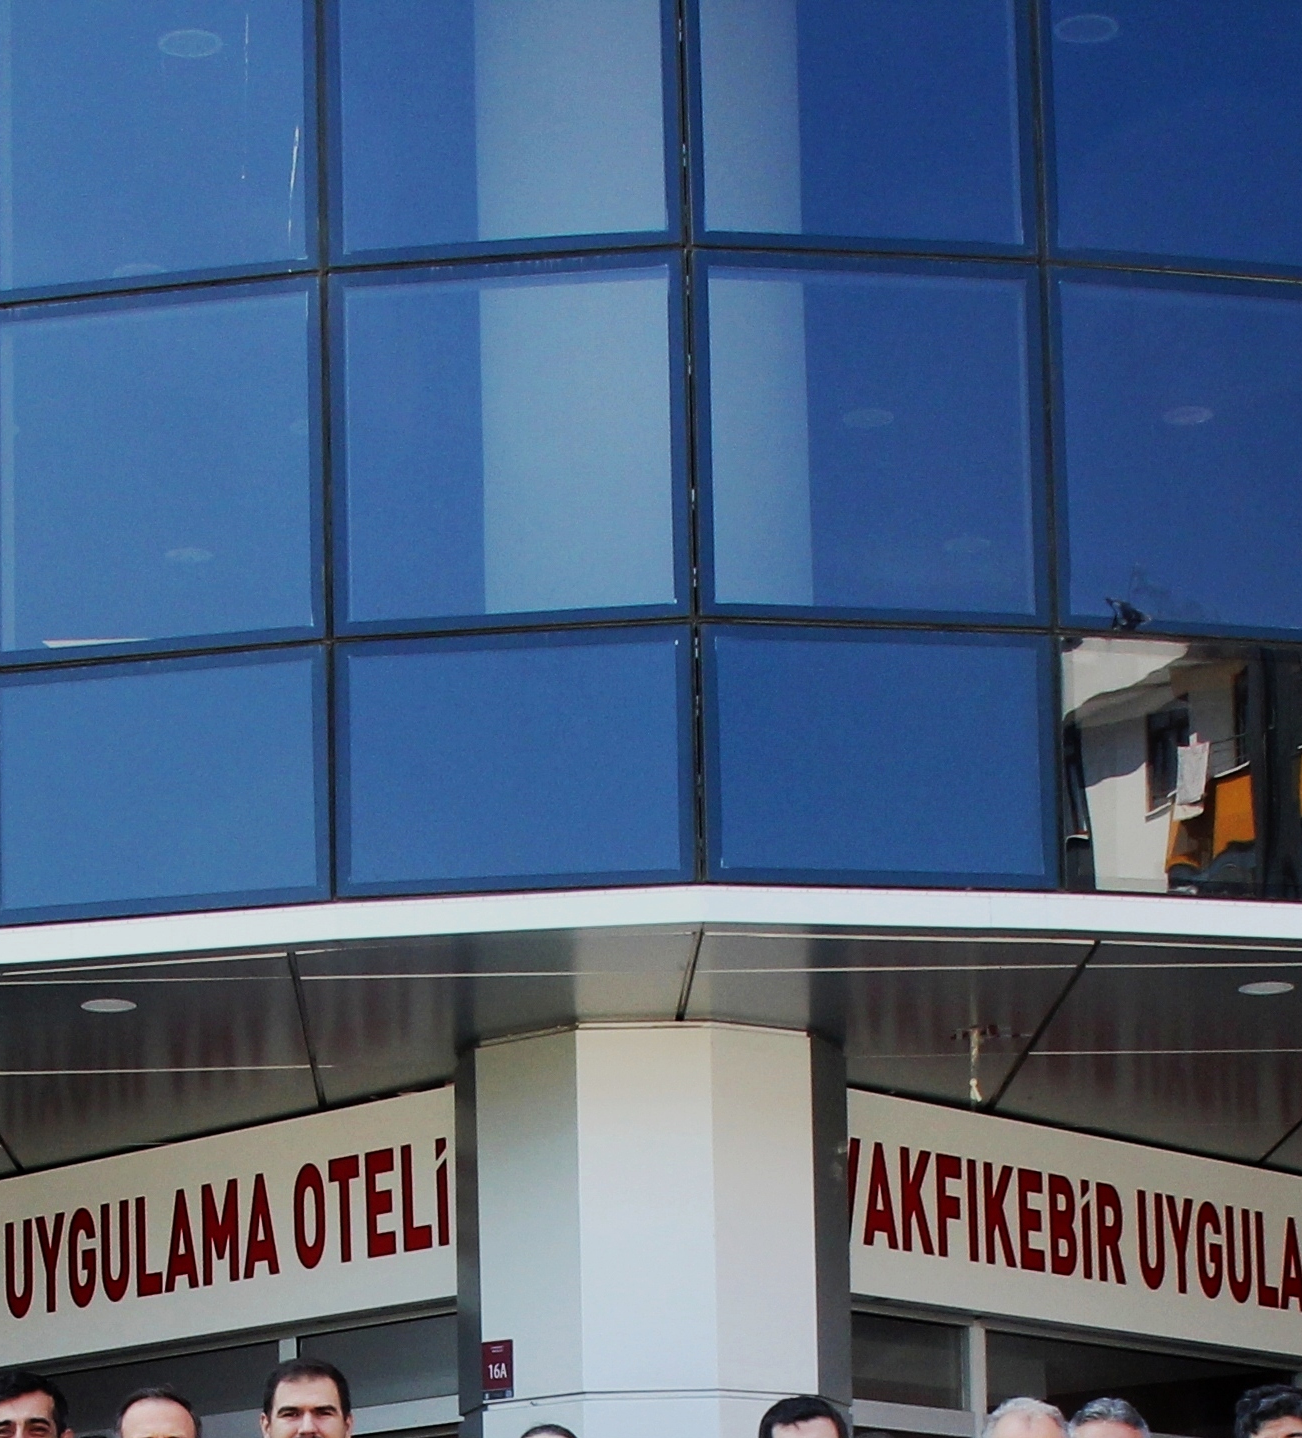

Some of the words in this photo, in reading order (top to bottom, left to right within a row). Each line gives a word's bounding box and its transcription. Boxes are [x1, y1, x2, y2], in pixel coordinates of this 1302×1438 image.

[4, 1172, 281, 1320] UYGULAMA
[293, 1137, 450, 1270] OTELİ
[487, 1362, 508, 1380] 16A
